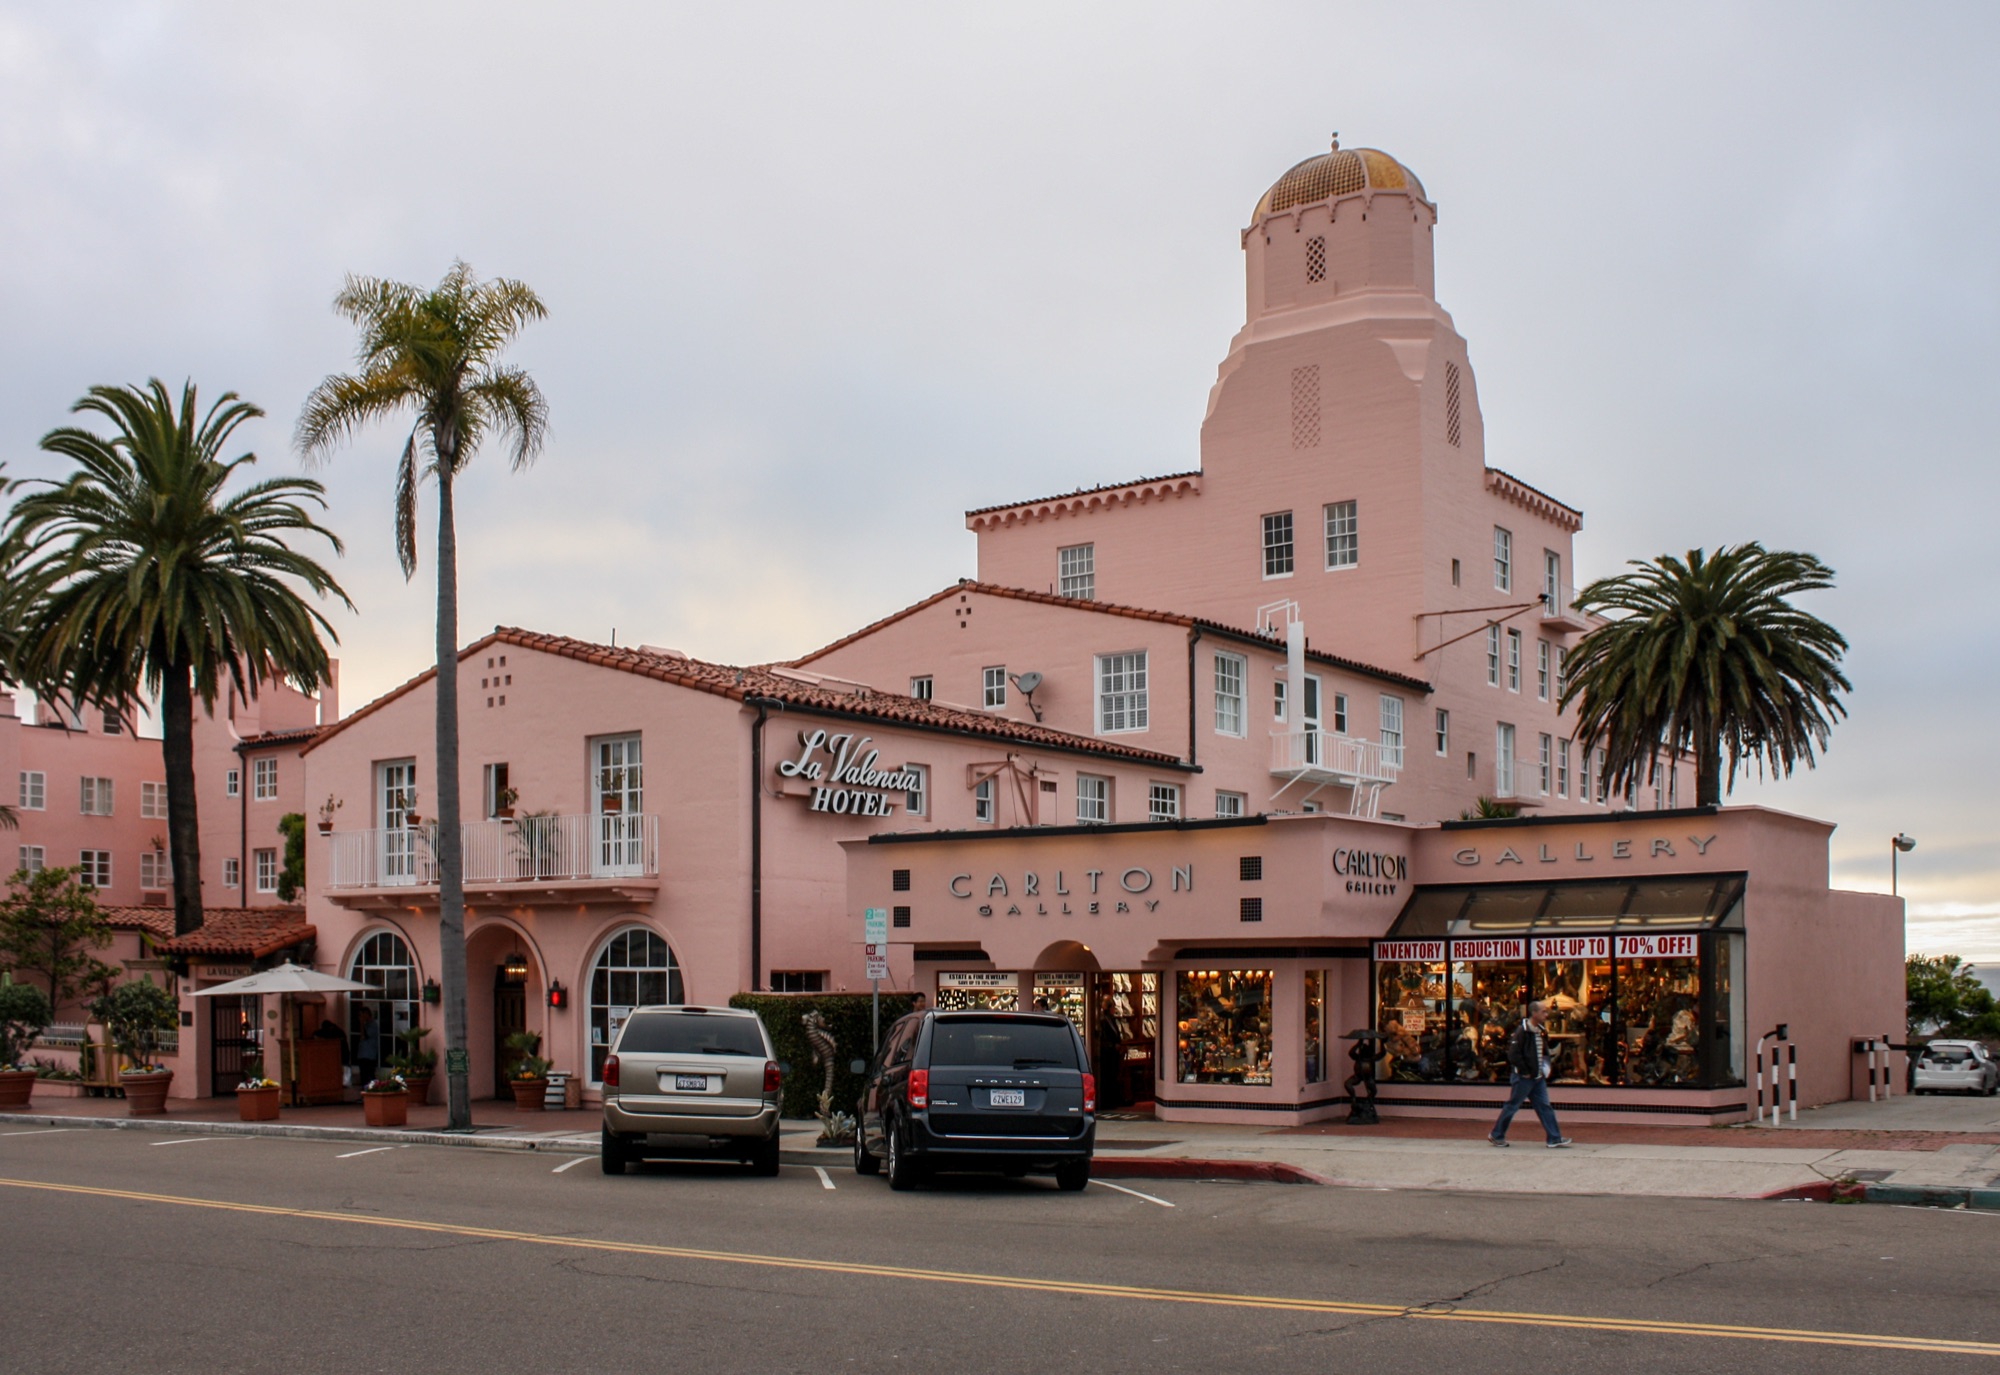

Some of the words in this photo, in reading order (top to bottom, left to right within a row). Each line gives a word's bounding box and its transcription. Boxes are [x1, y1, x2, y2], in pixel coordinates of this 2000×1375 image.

[780, 729, 822, 779] La
[829, 734, 918, 792] Valencia
[811, 787, 893, 817] HOTEL
[1332, 848, 1407, 881] CARLTON
[1452, 835, 1717, 866] GALLERY
[949, 863, 1192, 898] CARLTON
[1345, 881, 1396, 895] GALLERY
[978, 900, 1160, 917] GALLERY
[1378, 942, 1441, 959] INVENTORY
[1454, 941, 1520, 958] REDUCTION
[1536, 939, 1566, 957] SALE
[1569, 939, 1585, 956] UP
[1589, 938, 1605, 955] TO
[1619, 937, 1653, 955] 70%
[1657, 936, 1692, 954] OFF!
[993, 1095, 1022, 1104] 6ZWE129
